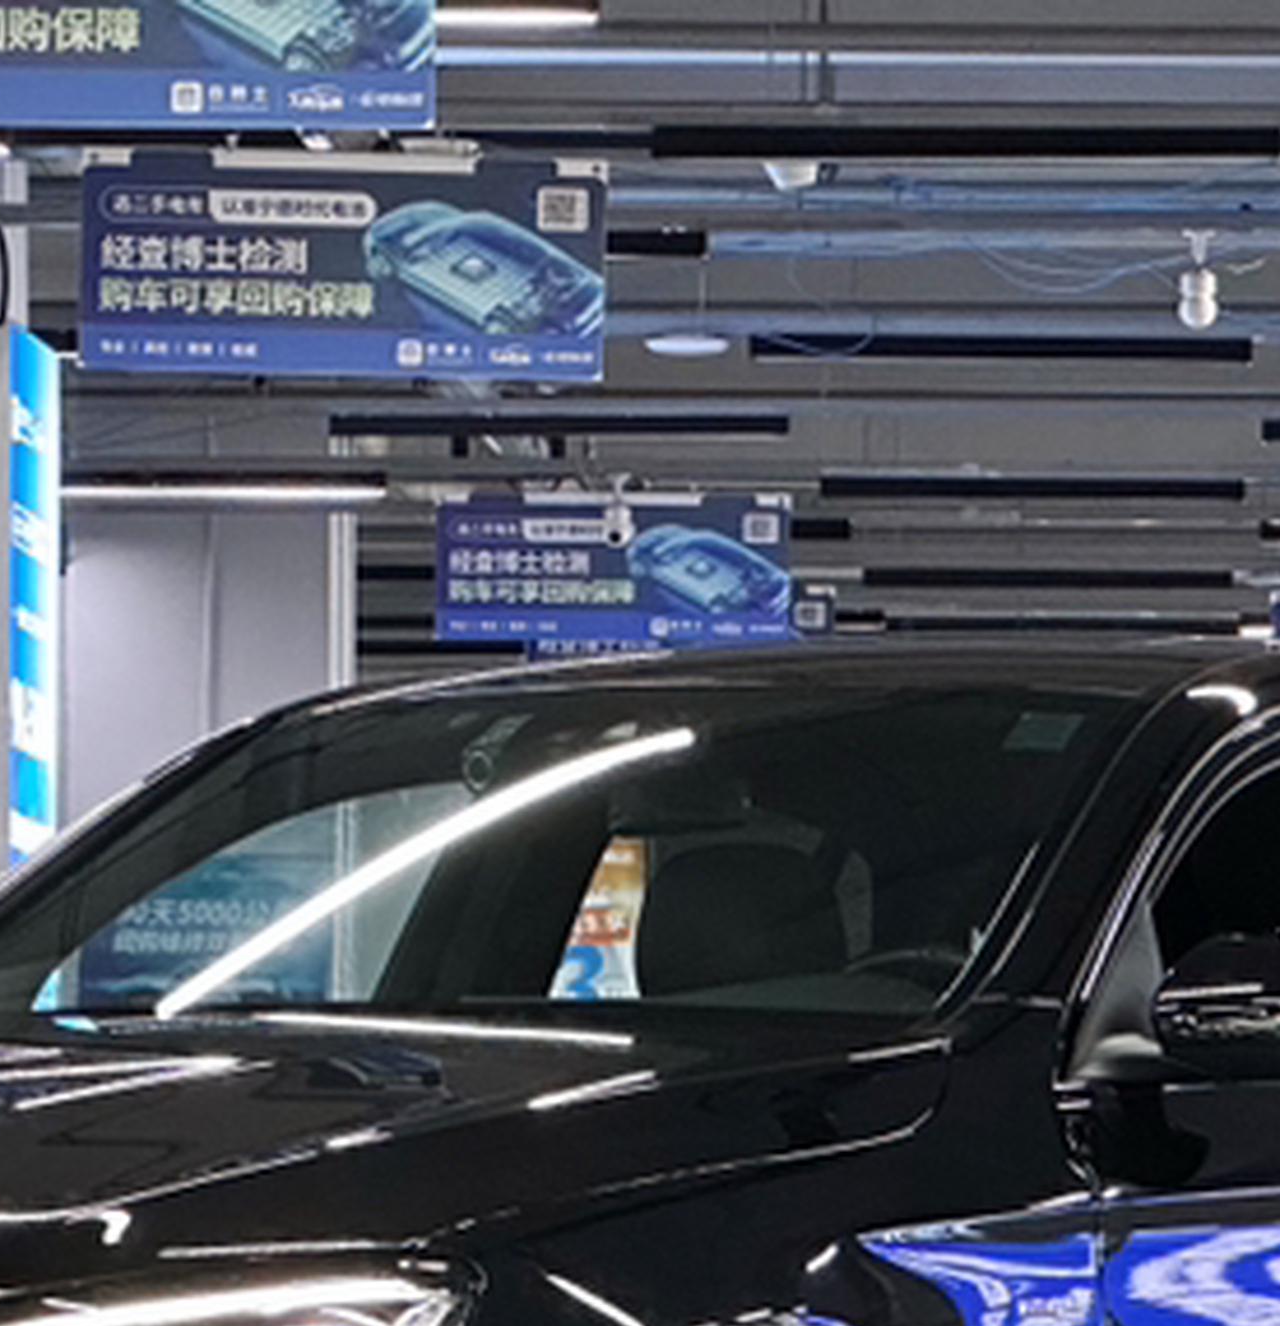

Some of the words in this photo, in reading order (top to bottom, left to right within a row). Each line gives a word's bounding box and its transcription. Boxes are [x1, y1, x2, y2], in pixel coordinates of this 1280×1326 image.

[100, 232, 308, 274] 经查博士检测
[99, 277, 374, 317] 购车可享回购保障
